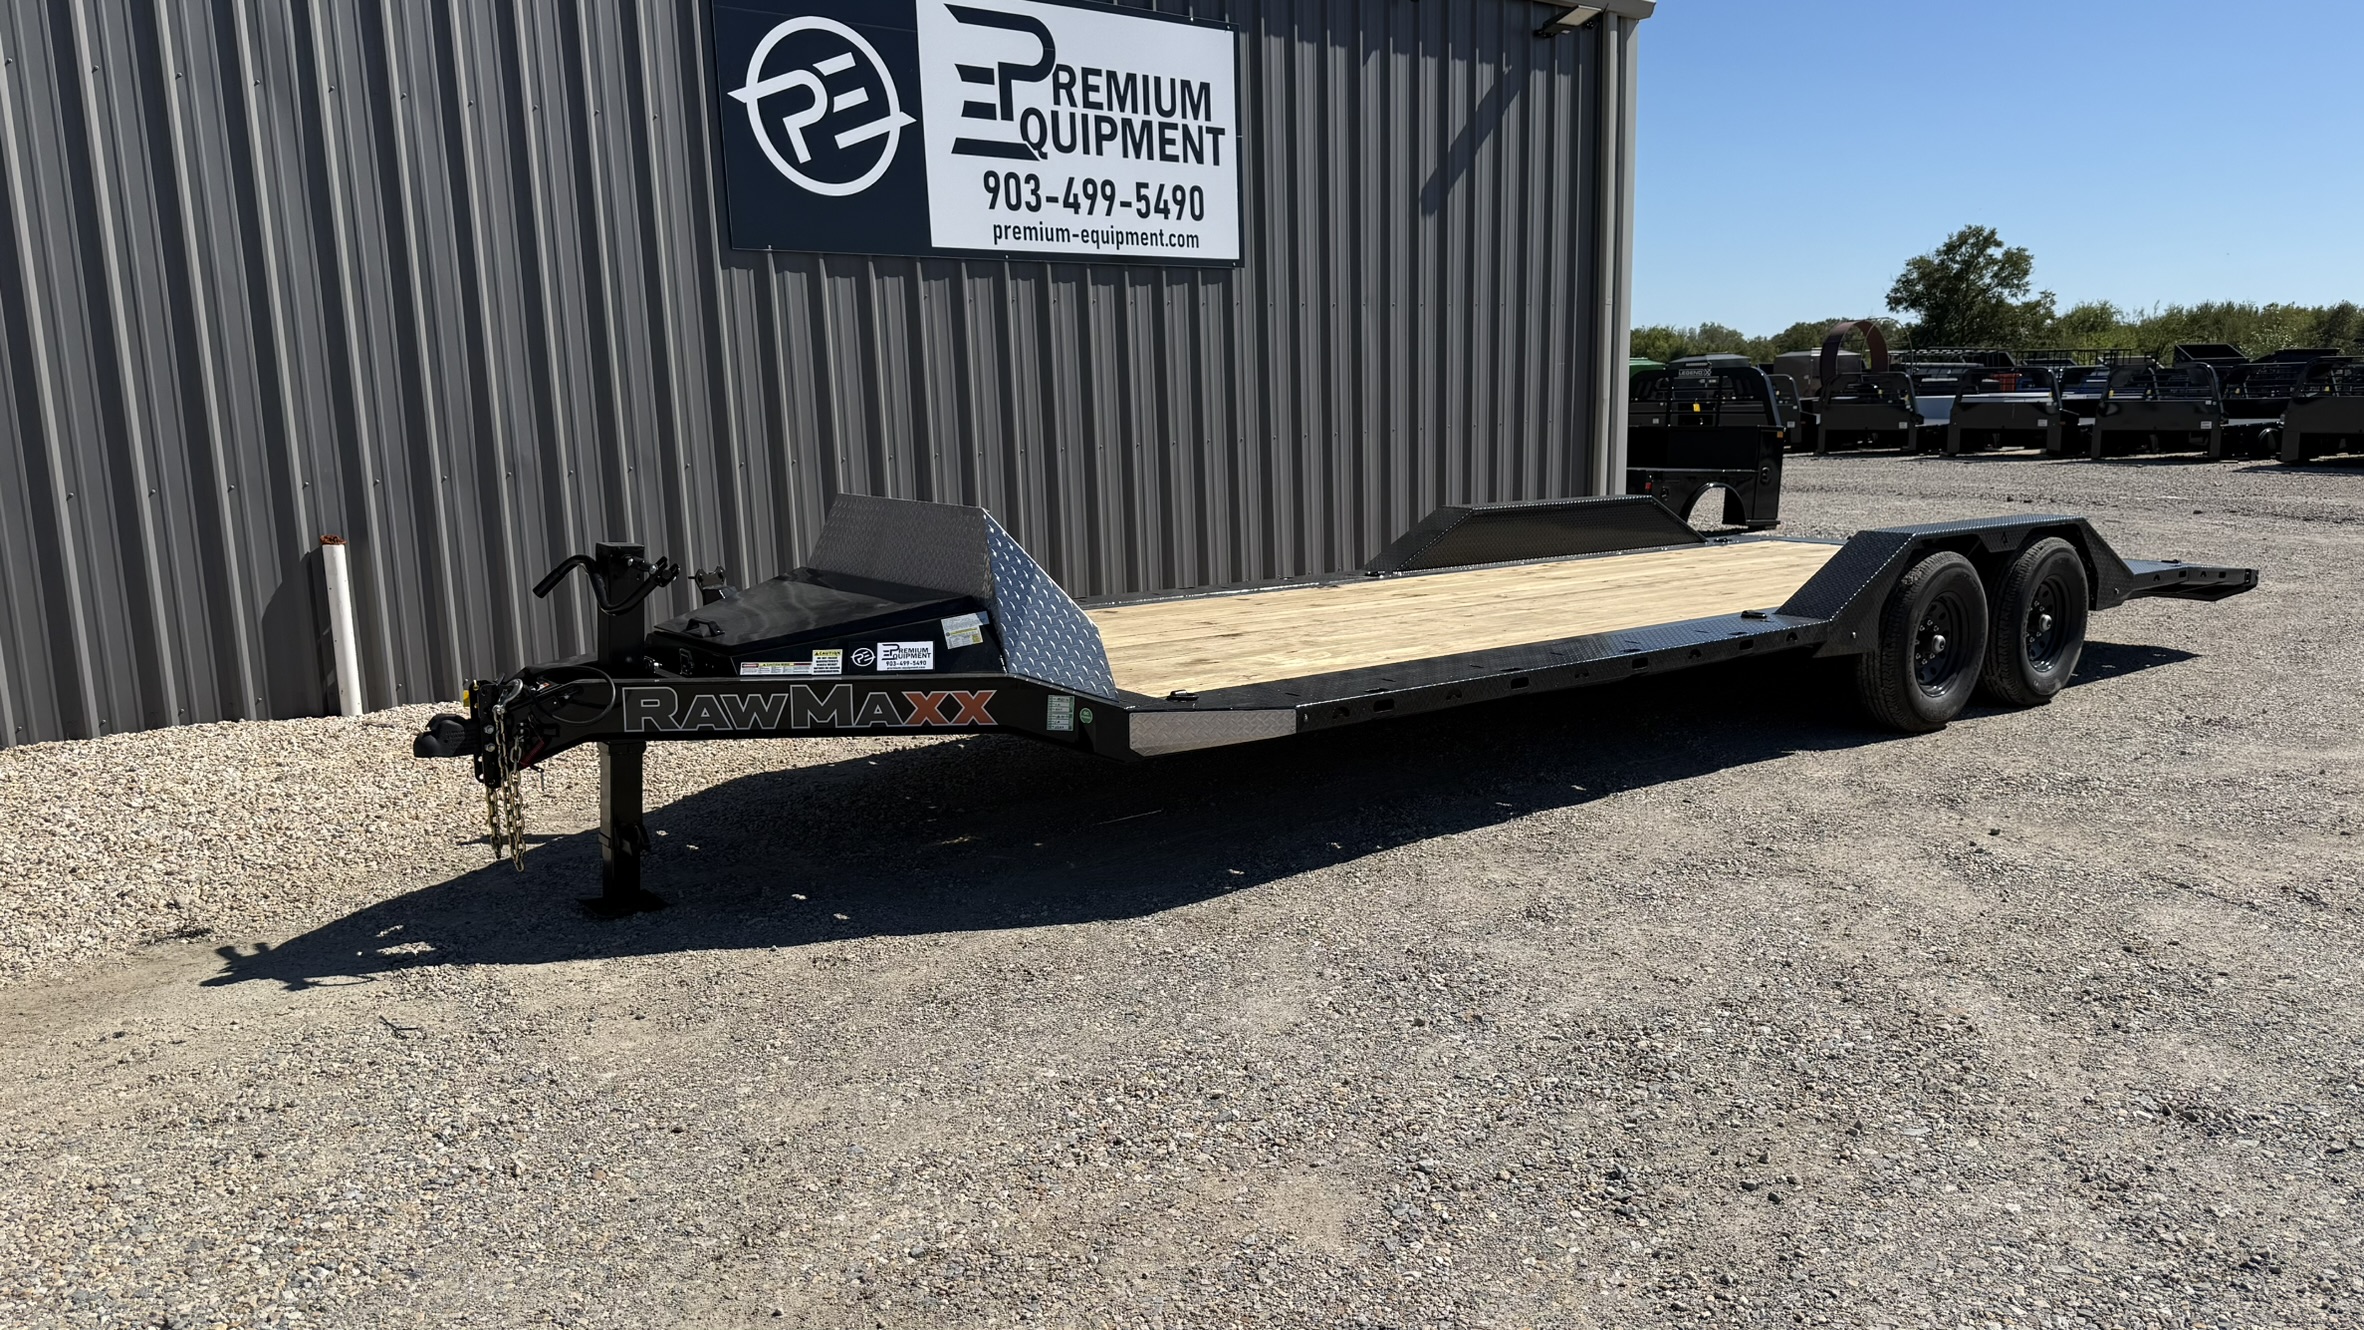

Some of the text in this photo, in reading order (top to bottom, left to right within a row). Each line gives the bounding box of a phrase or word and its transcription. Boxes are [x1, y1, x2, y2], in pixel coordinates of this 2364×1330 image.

[943, 3, 1212, 122] PREMIUM
[983, 169, 1205, 222] 903-499-5490
[993, 221, 1200, 250] premium-equipment.com
